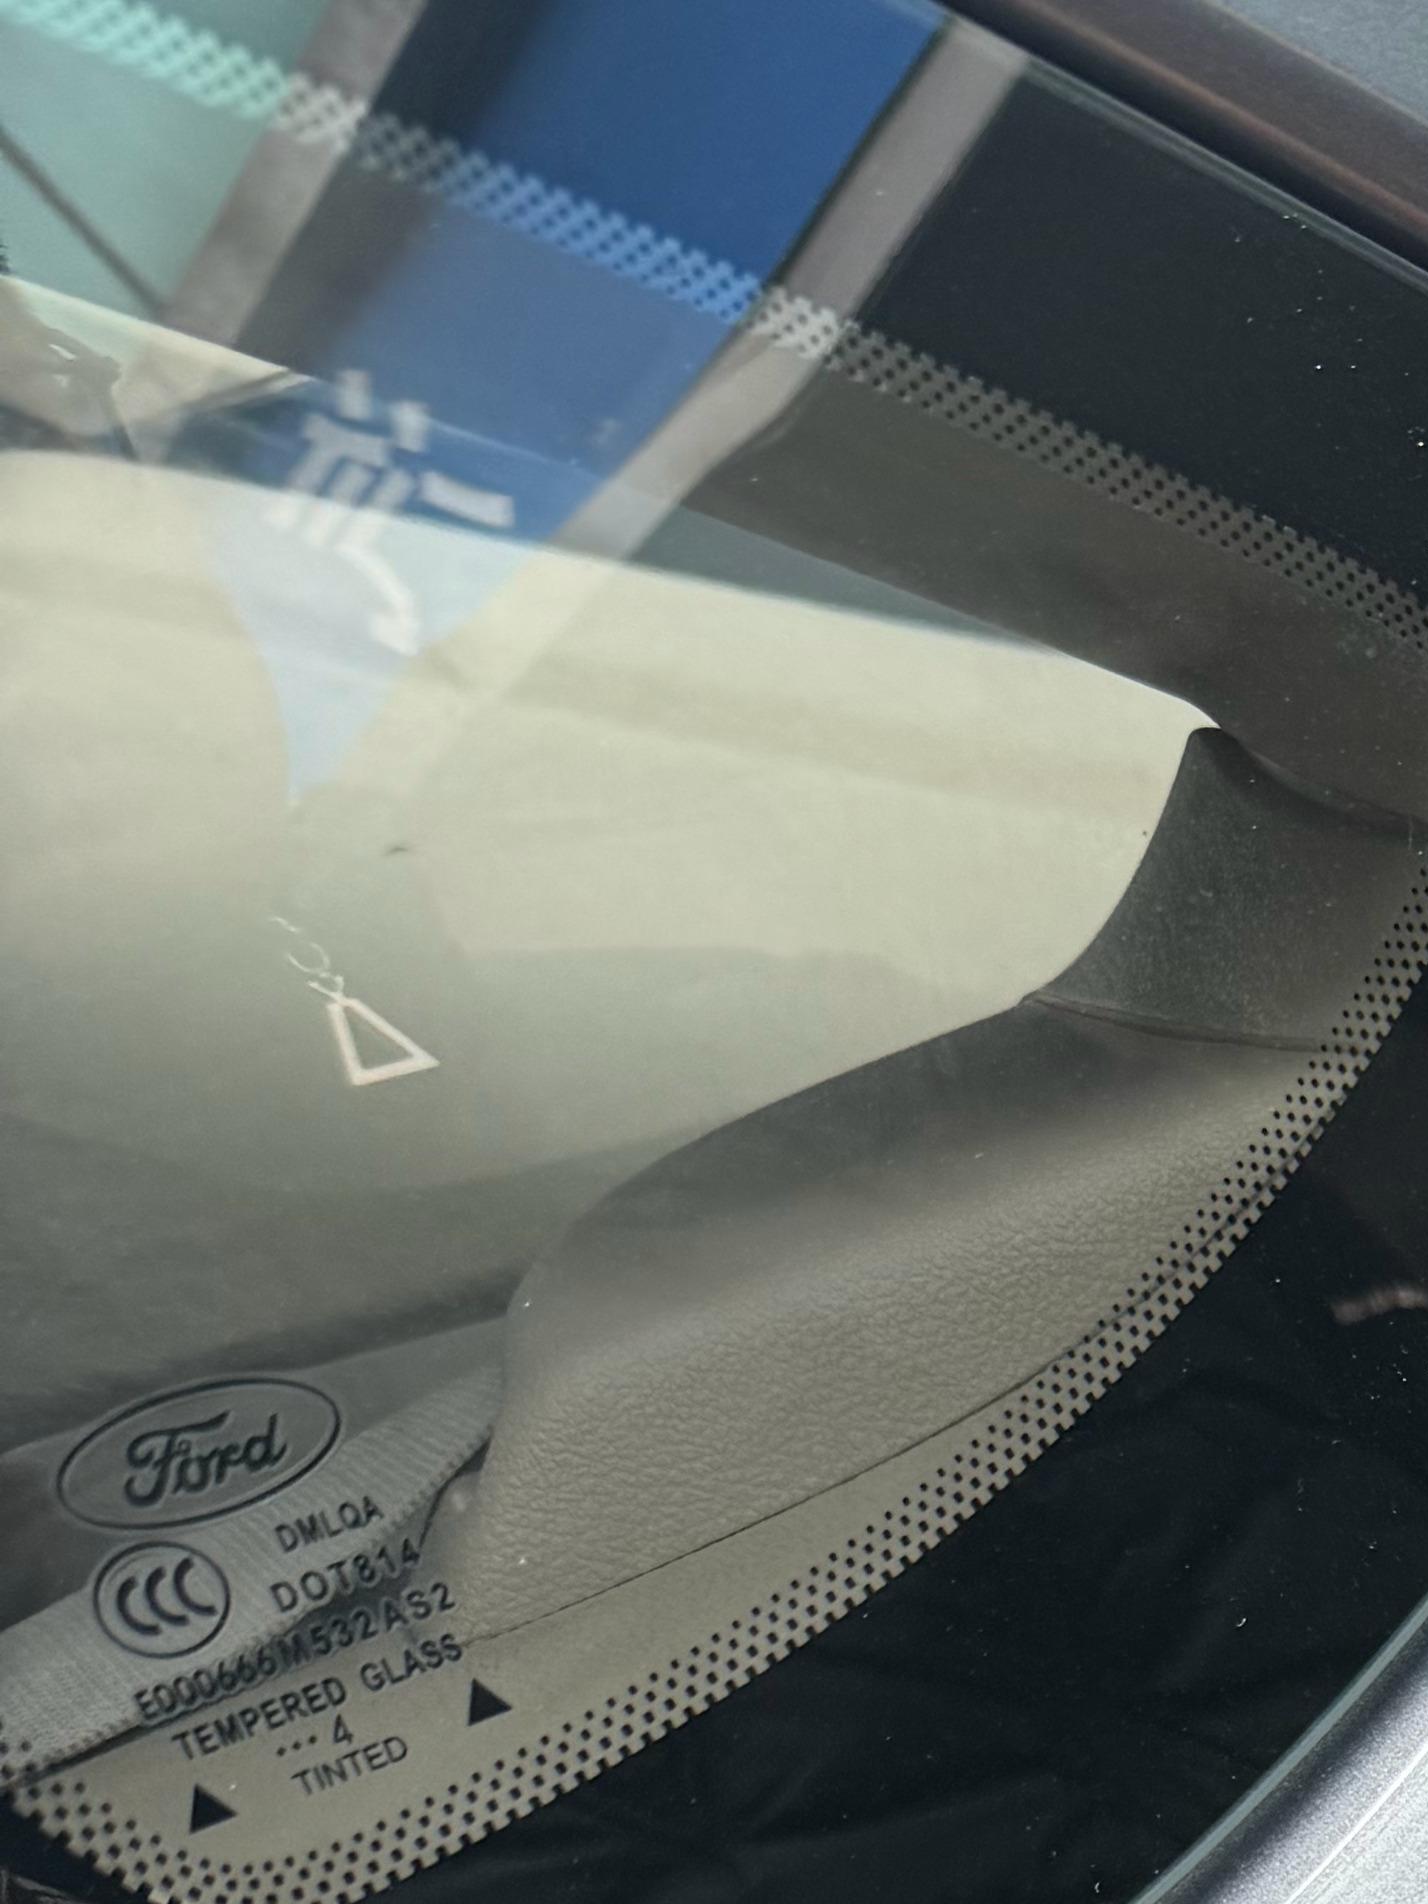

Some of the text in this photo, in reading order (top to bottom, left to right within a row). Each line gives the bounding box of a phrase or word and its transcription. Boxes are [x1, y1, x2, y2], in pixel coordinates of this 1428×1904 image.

[124, 1409, 288, 1508] Ford
[269, 1538, 421, 1613] DOT814
[171, 1633, 462, 1760] TEMPERED GLASS
[291, 1736, 408, 1796] TINTED
